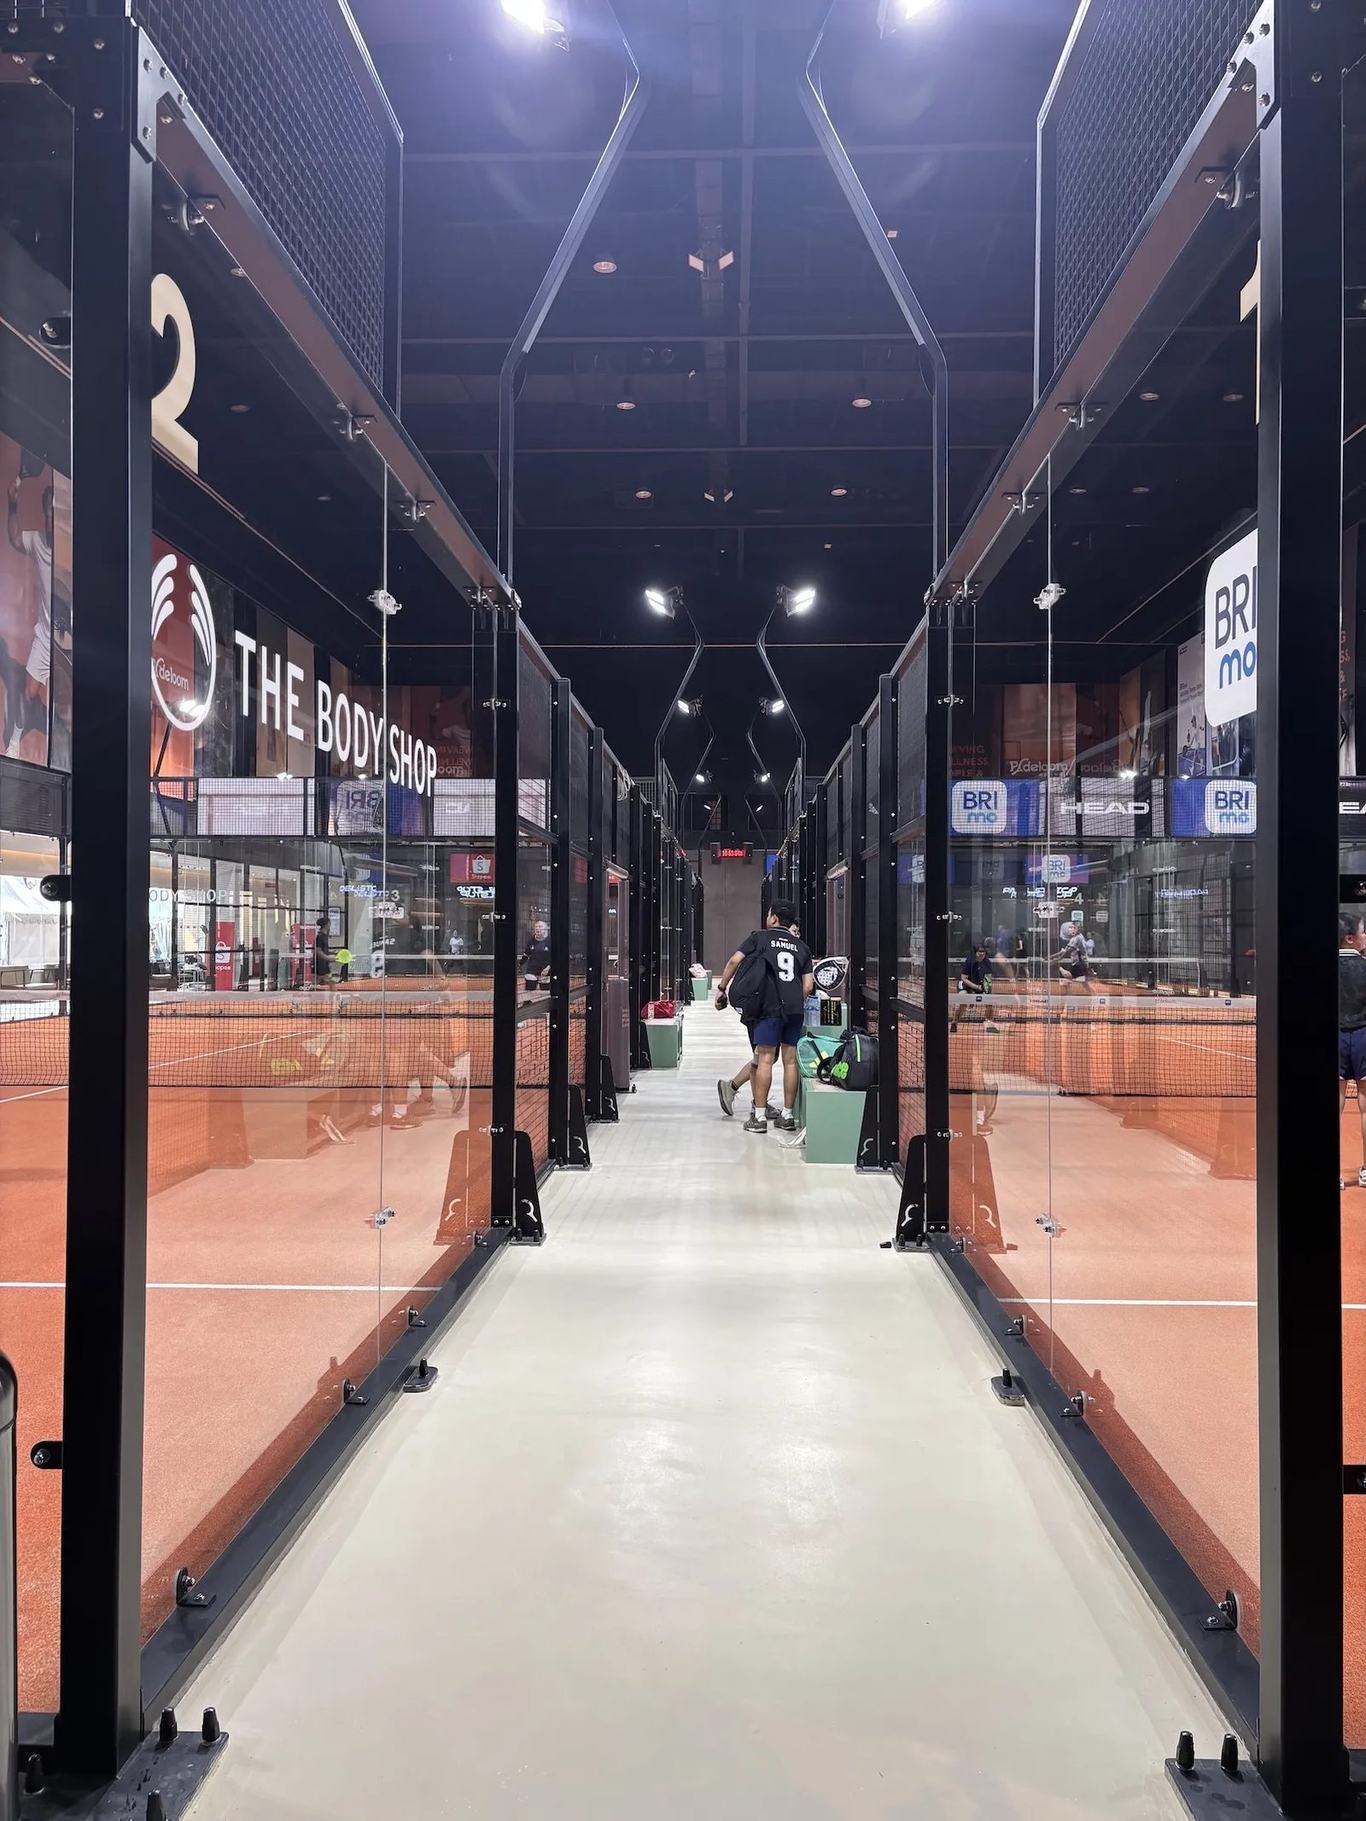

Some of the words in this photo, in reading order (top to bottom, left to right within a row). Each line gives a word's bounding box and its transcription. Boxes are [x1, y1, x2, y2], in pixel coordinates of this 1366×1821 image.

[151, 273, 198, 474] 2
[1215, 566, 1257, 650] BRI
[1219, 641, 1257, 689] mo
[235, 630, 305, 742] THE
[317, 680, 384, 776] BODY
[389, 724, 437, 798] SHOP
[963, 791, 998, 810] BRI
[1060, 801, 1150, 815] HEAD
[1215, 790, 1249, 810] BRI
[149, 889, 180, 902] ODY
[390, 889, 400, 902] 3
[770, 940, 799, 952] SAMUEL
[776, 951, 795, 982] 9
